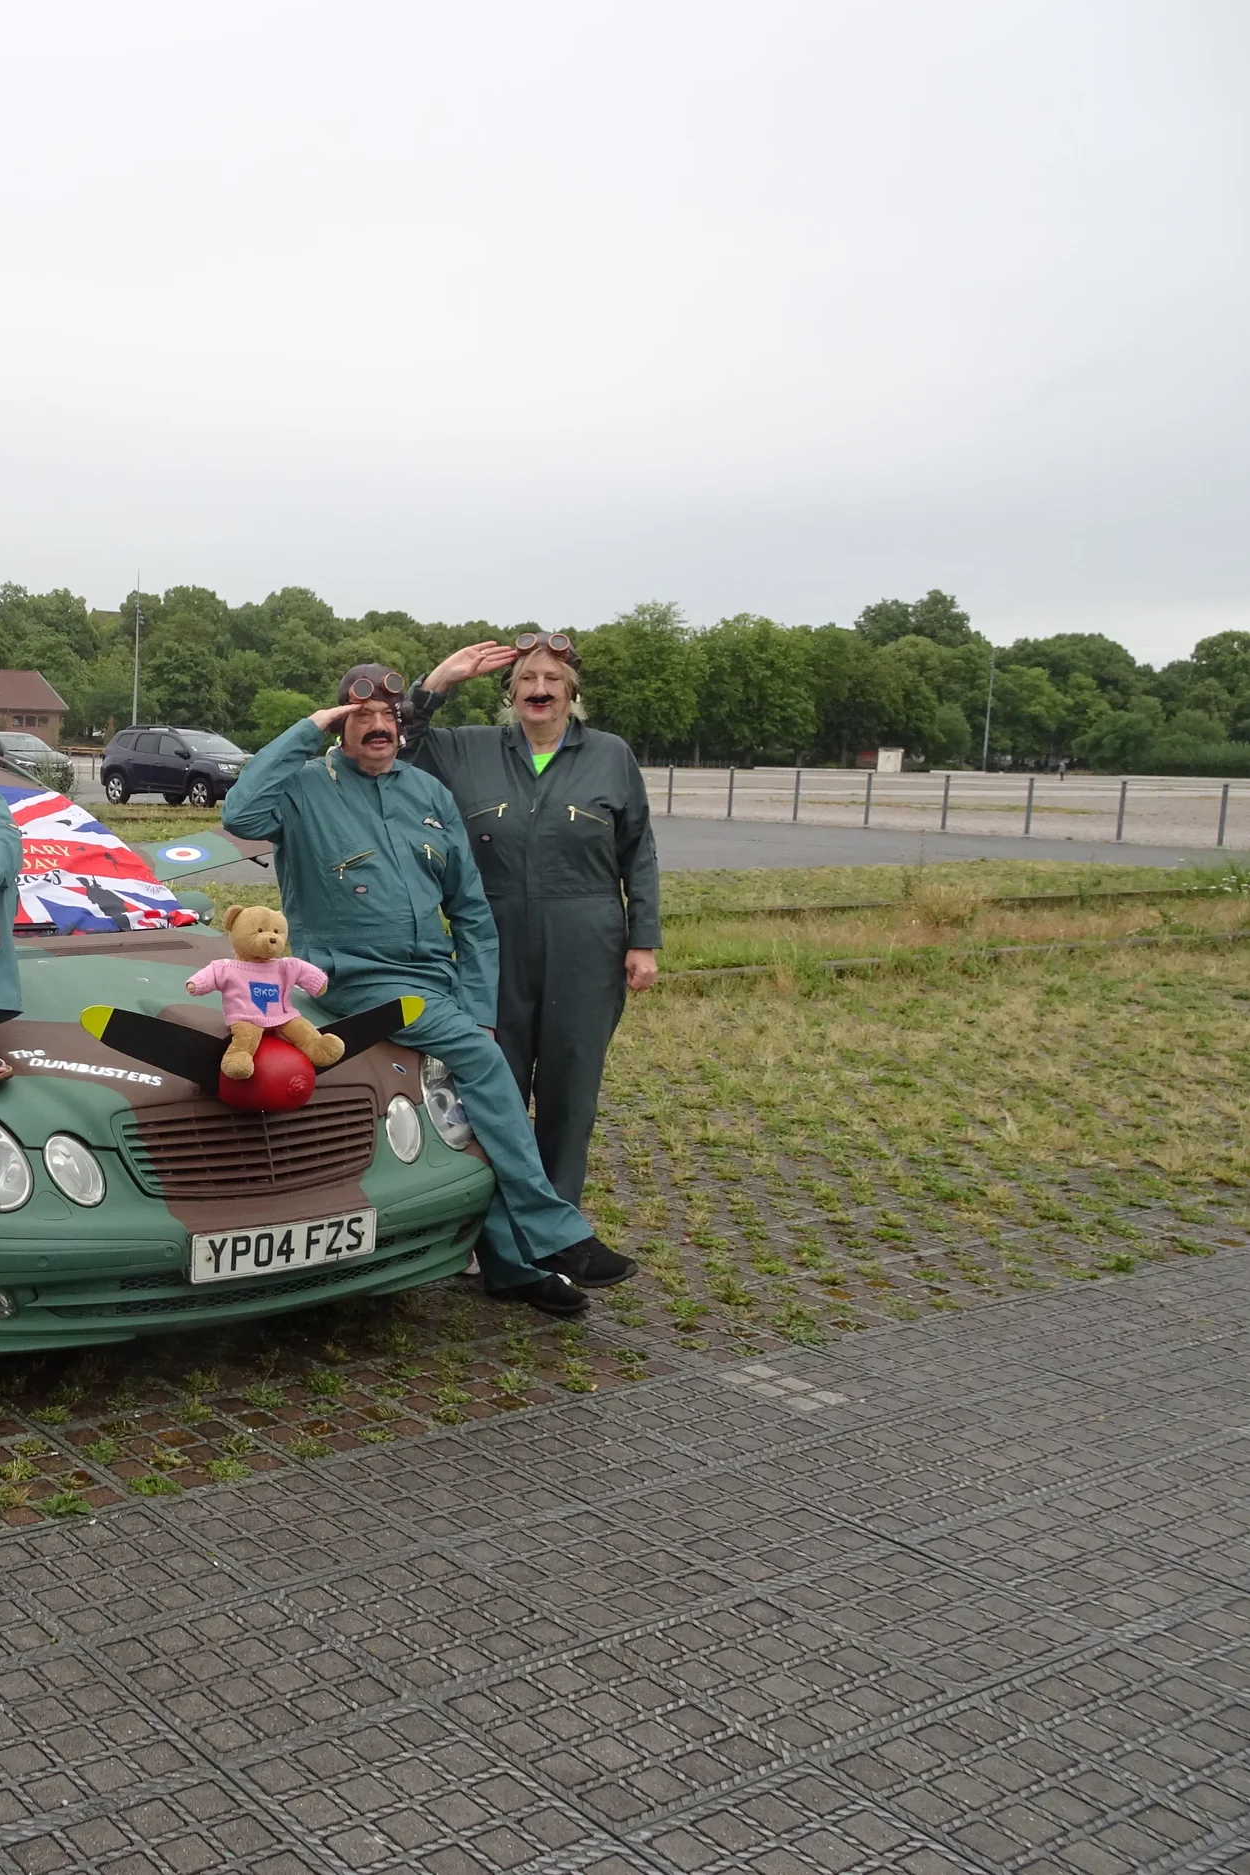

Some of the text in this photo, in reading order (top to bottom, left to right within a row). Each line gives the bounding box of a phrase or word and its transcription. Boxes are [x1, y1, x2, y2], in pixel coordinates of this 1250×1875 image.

[22, 844, 70, 857] SARY
[8, 1049, 46, 1060] The
[29, 1057, 163, 1086] DUMBUSTERS
[208, 1216, 363, 1274] YP04 FZS
